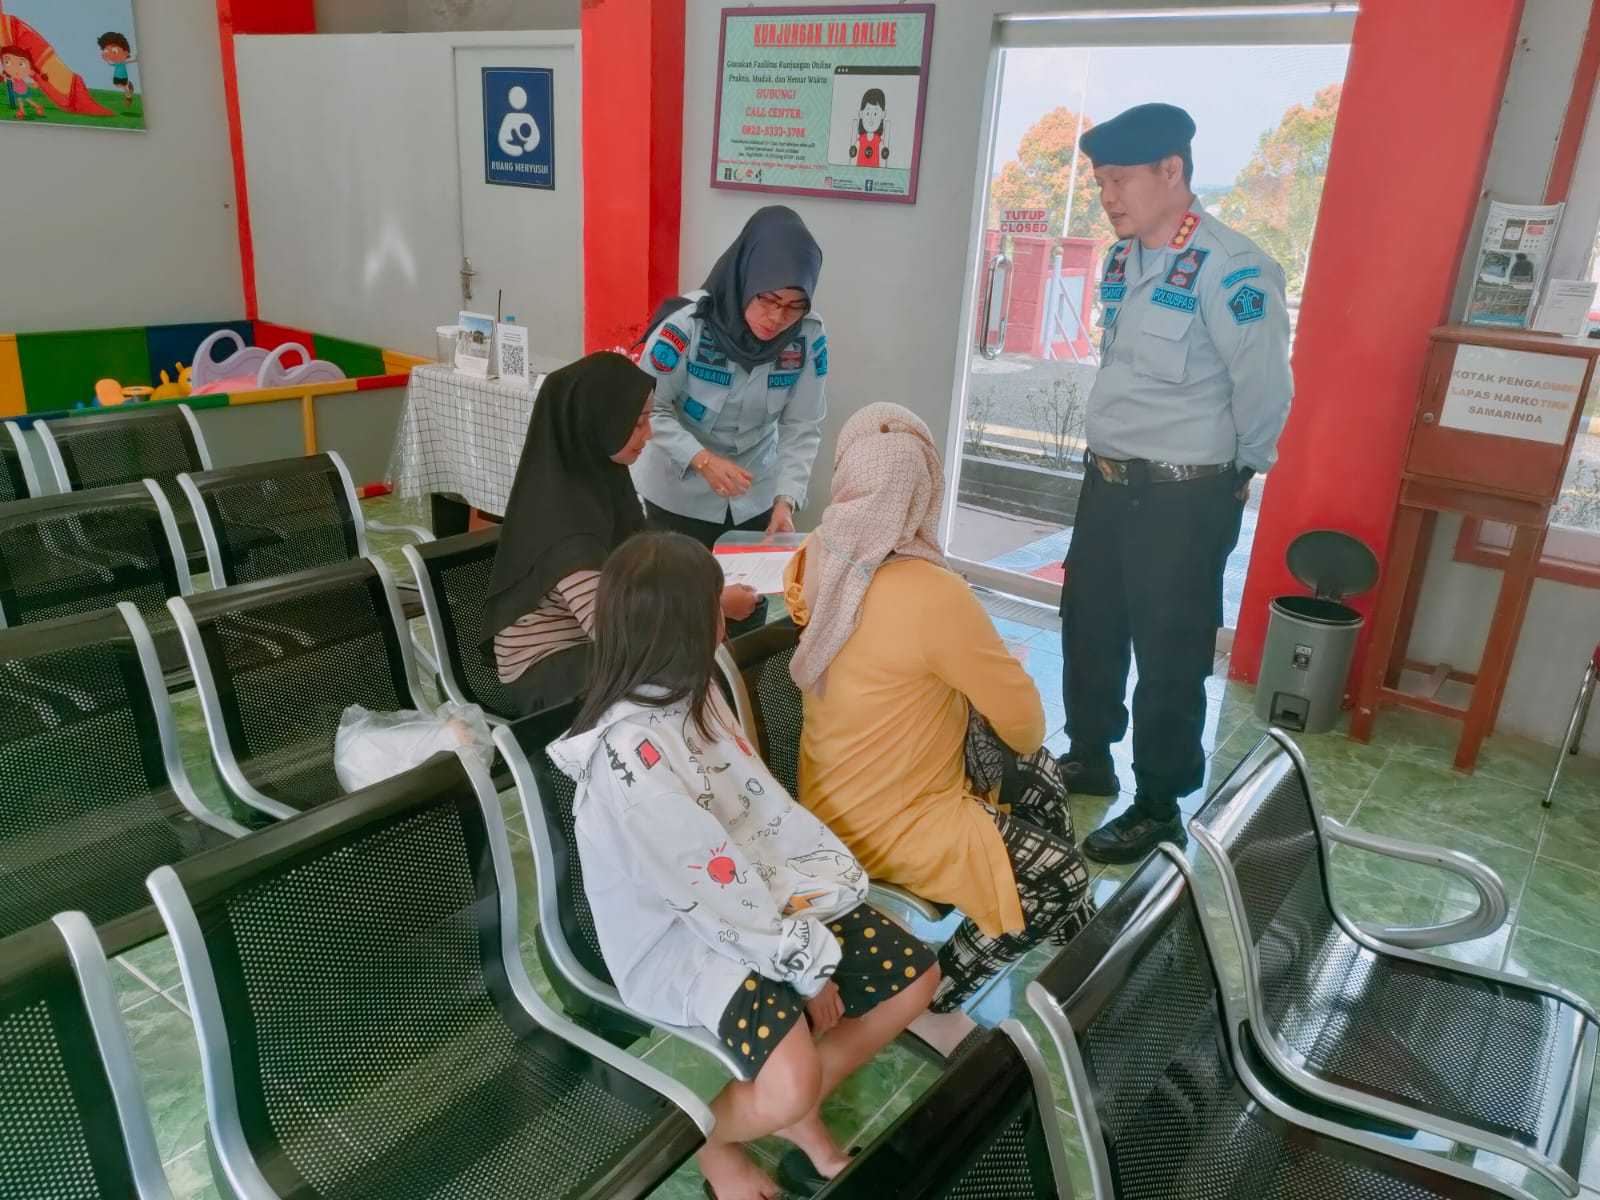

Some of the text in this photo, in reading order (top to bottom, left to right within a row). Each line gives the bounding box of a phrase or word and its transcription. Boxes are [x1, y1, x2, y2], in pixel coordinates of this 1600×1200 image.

[754, 21, 896, 46] KUNJUNGAN VIA ONLINE
[745, 107, 767, 117] CALL
[491, 161, 514, 171] RUANG
[1004, 210, 1046, 220] TUTUP
[1000, 223, 1048, 233] CLOSED
[1453, 369, 1495, 383] KOTAK
[1452, 386, 1491, 400] LAPAS
[1467, 405, 1543, 424] SAMARINDA
